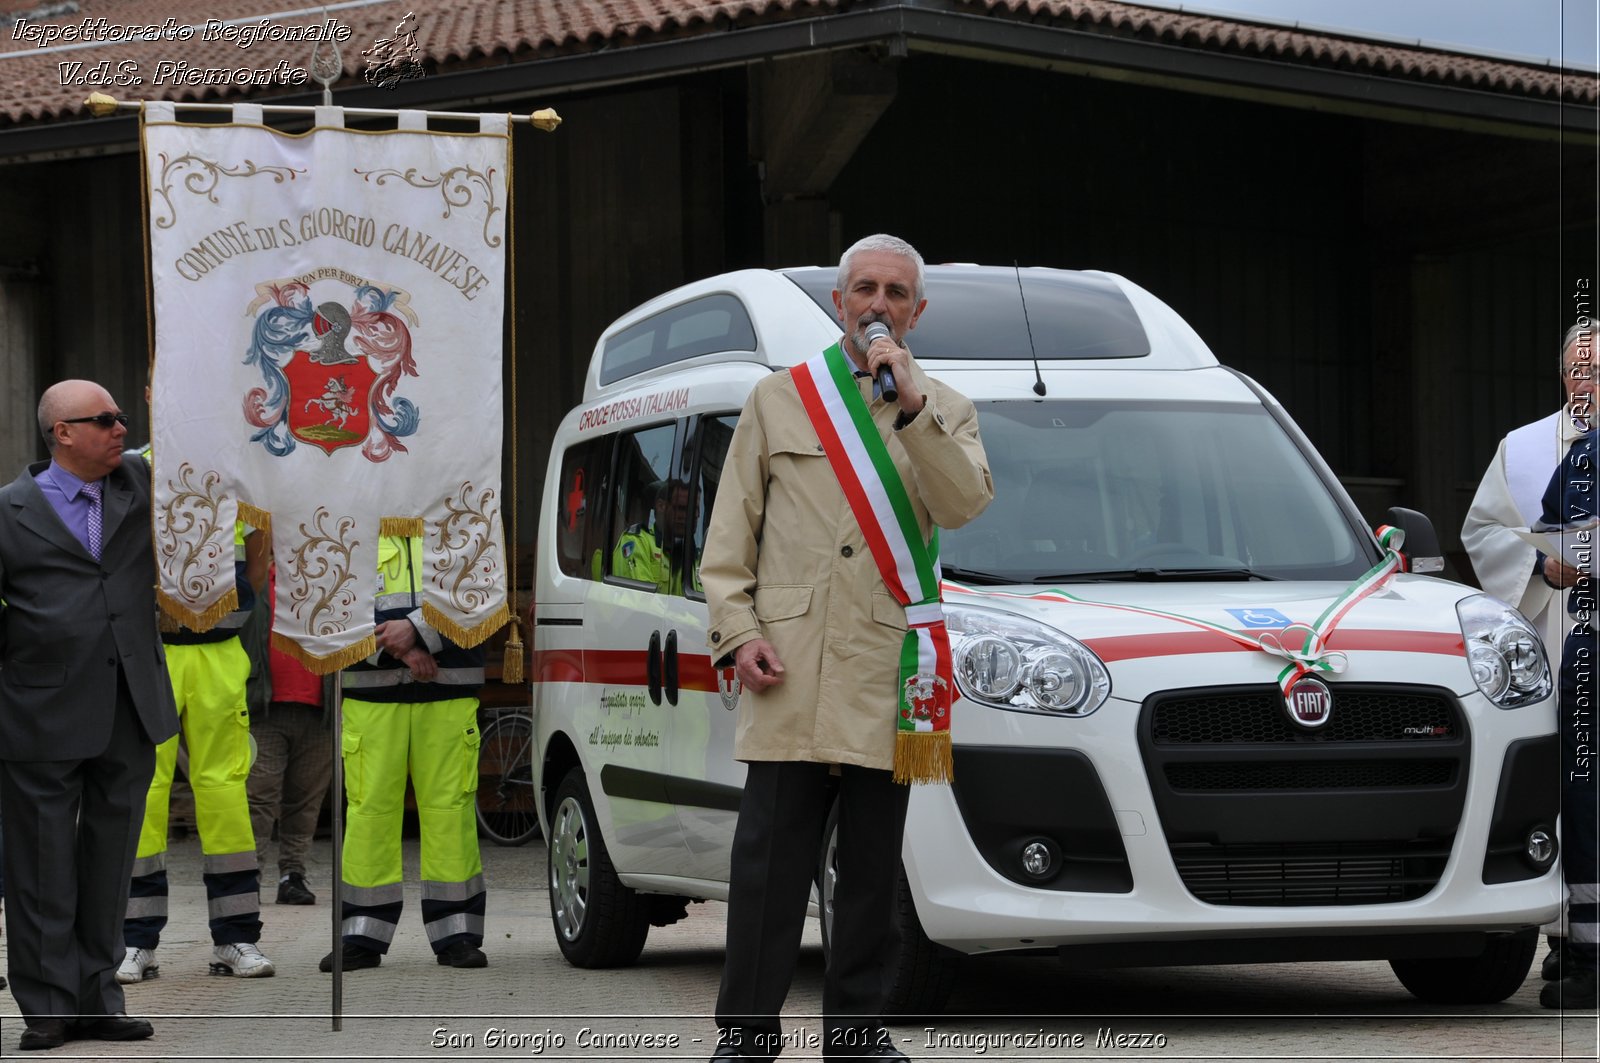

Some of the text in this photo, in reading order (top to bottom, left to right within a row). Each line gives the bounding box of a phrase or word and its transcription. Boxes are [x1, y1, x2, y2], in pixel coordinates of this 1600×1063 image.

[174, 220, 258, 282] COMUNE
[254, 226, 280, 250] DI
[382, 223, 490, 301] CANAVESE
[318, 268, 338, 279] PER
[579, 387, 690, 431] CROCE ROSSA ITALIANA
[1296, 692, 1322, 713] FIAT
